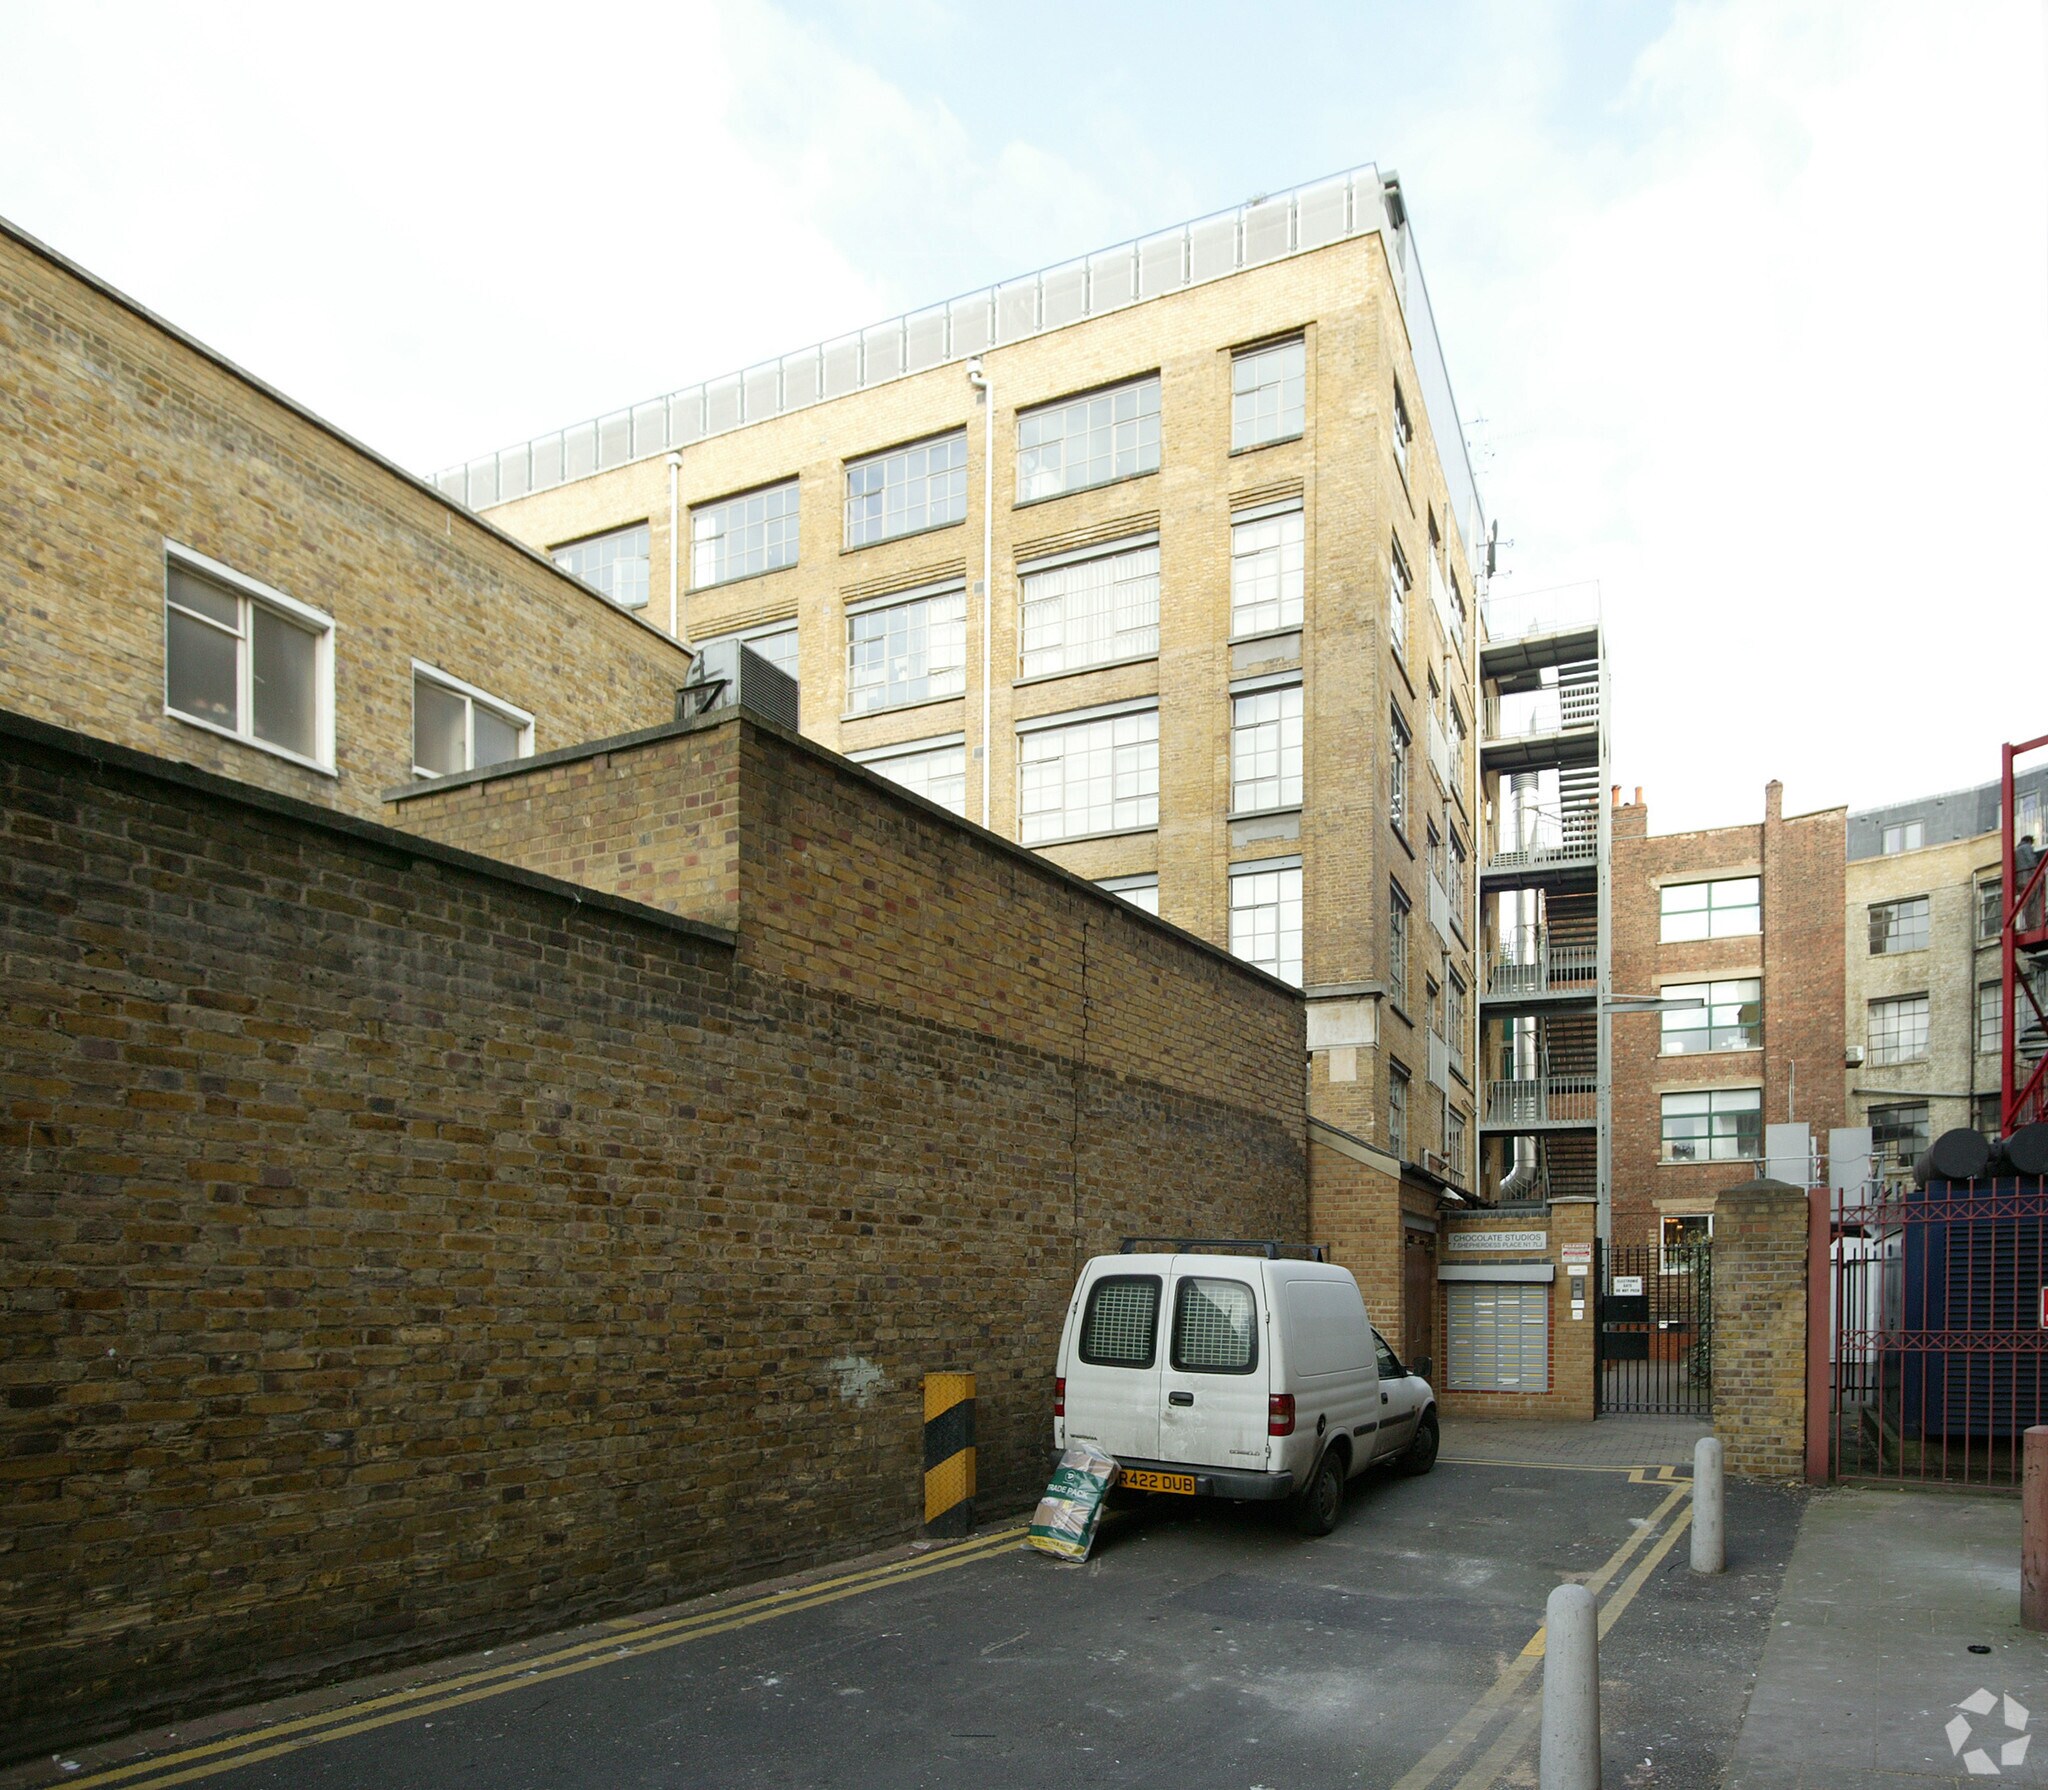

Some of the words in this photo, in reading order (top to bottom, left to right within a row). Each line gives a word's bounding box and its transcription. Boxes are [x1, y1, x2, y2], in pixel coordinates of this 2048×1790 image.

[1453, 1234, 1502, 1242] CHOCOLATE
[1505, 1233, 1542, 1242] STUDIOS
[1119, 1470, 1158, 1488] R422
[1162, 1475, 1193, 1492] DUB
[1067, 1487, 1089, 1499] PACK
